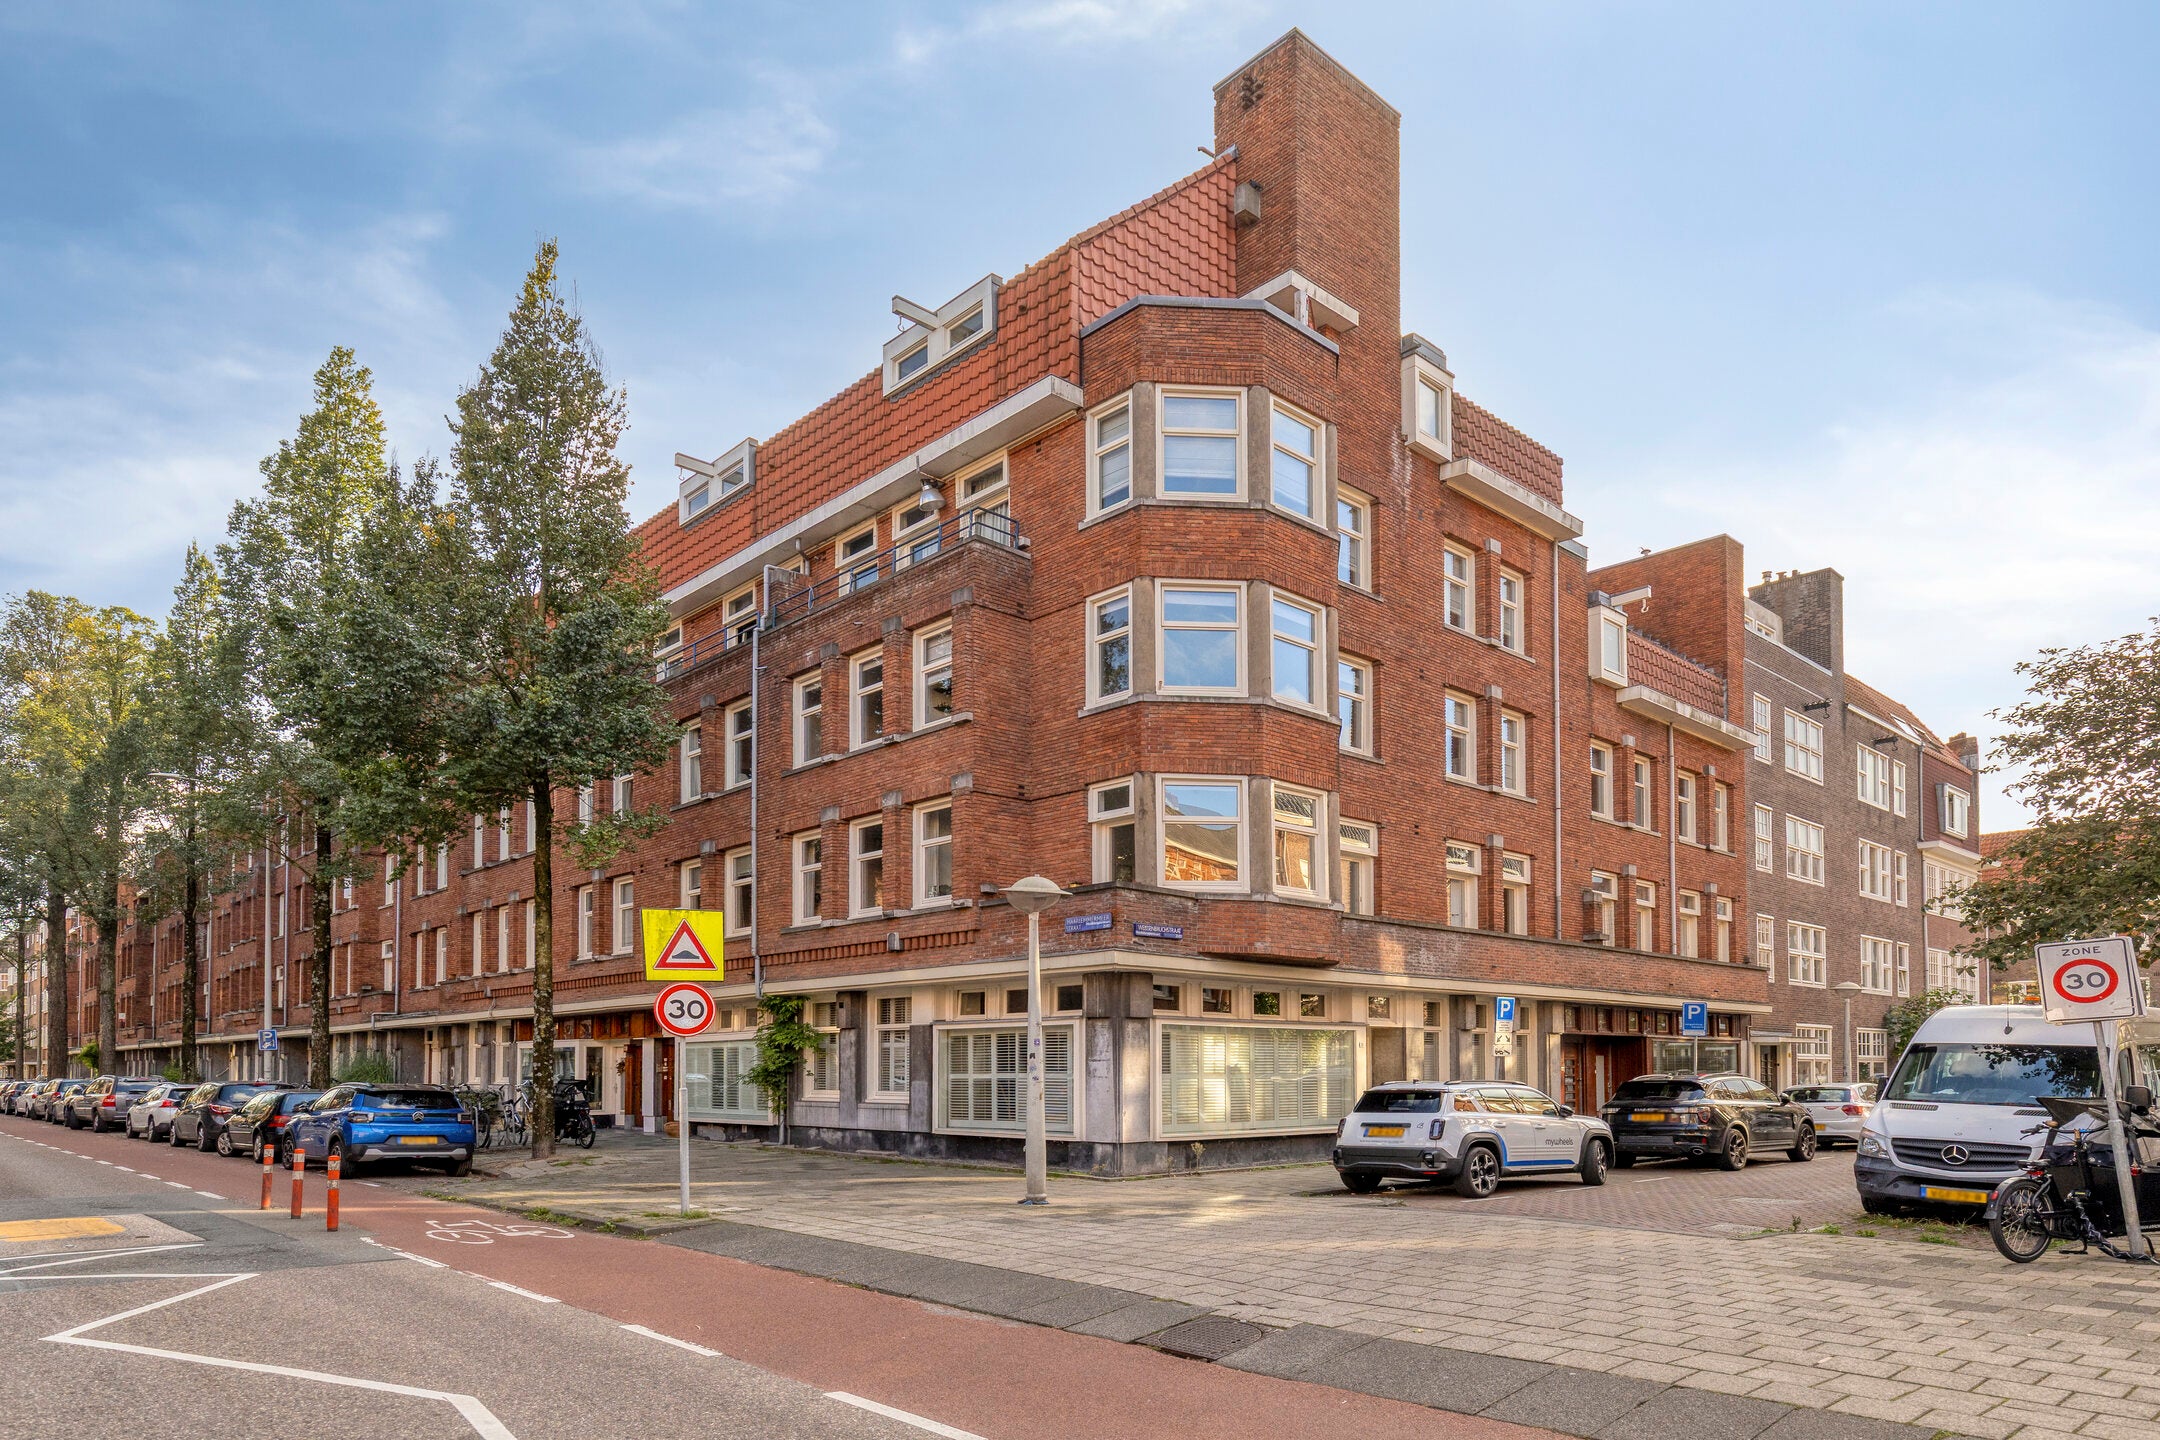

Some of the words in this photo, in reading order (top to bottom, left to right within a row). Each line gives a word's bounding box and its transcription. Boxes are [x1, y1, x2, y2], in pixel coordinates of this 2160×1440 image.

[2061, 946, 2102, 957] ZONE
[2066, 972, 2106, 990] 30
[668, 999, 705, 1020] 30
[1501, 1000, 1511, 1018] P
[1688, 1005, 1701, 1020] P
[262, 1031, 273, 1043] P
[1544, 1136, 1574, 1147] mywheels
